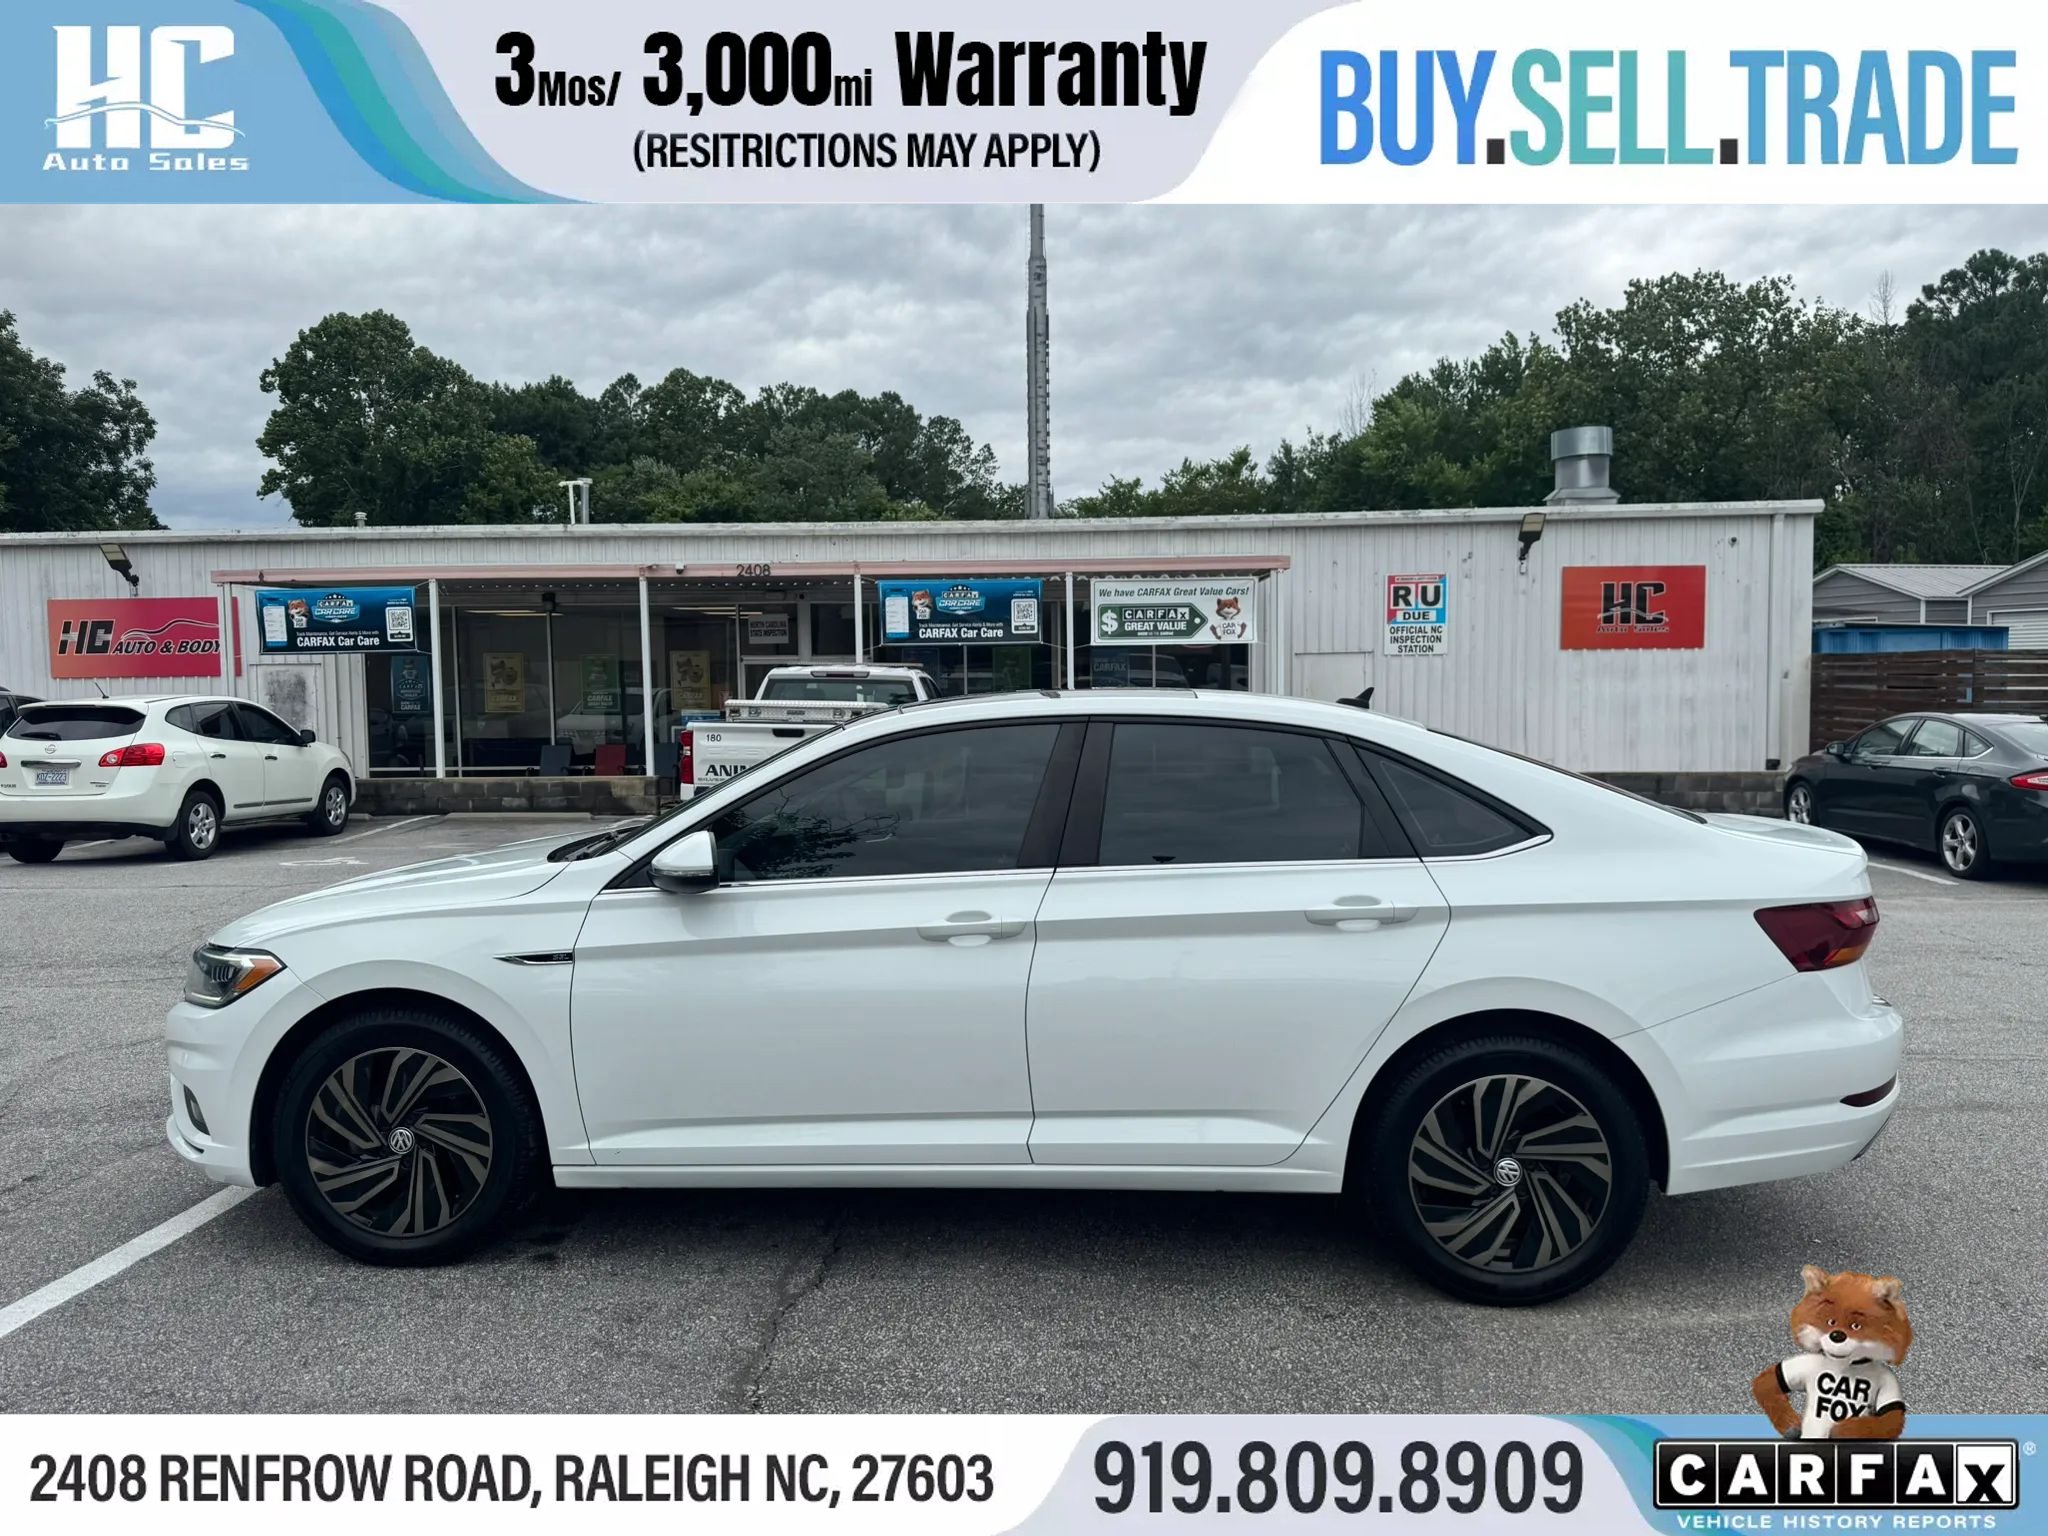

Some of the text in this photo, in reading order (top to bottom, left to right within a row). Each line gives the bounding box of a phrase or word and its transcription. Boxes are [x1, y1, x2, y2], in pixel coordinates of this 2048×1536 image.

[736, 564, 771, 577] 2408
[1099, 586, 1250, 598] We have CARFAX Great Value Cars!
[1392, 585, 1441, 607] R U
[1600, 581, 1667, 625] HC
[1124, 608, 1188, 620] CARFAX
[1403, 611, 1430, 620] DUE
[1124, 621, 1187, 631] GREAT VALUE
[1389, 625, 1443, 634] OFFICIAL NC
[57, 619, 221, 656] HC AUTO & BODY
[919, 627, 1003, 639] CARFAX Car Care
[297, 635, 380, 647] CARFAX Car Care
[1390, 635, 1442, 644] INSPECTION
[1397, 644, 1434, 653] STATION
[706, 734, 722, 742] 180
[705, 764, 746, 777] ANI
